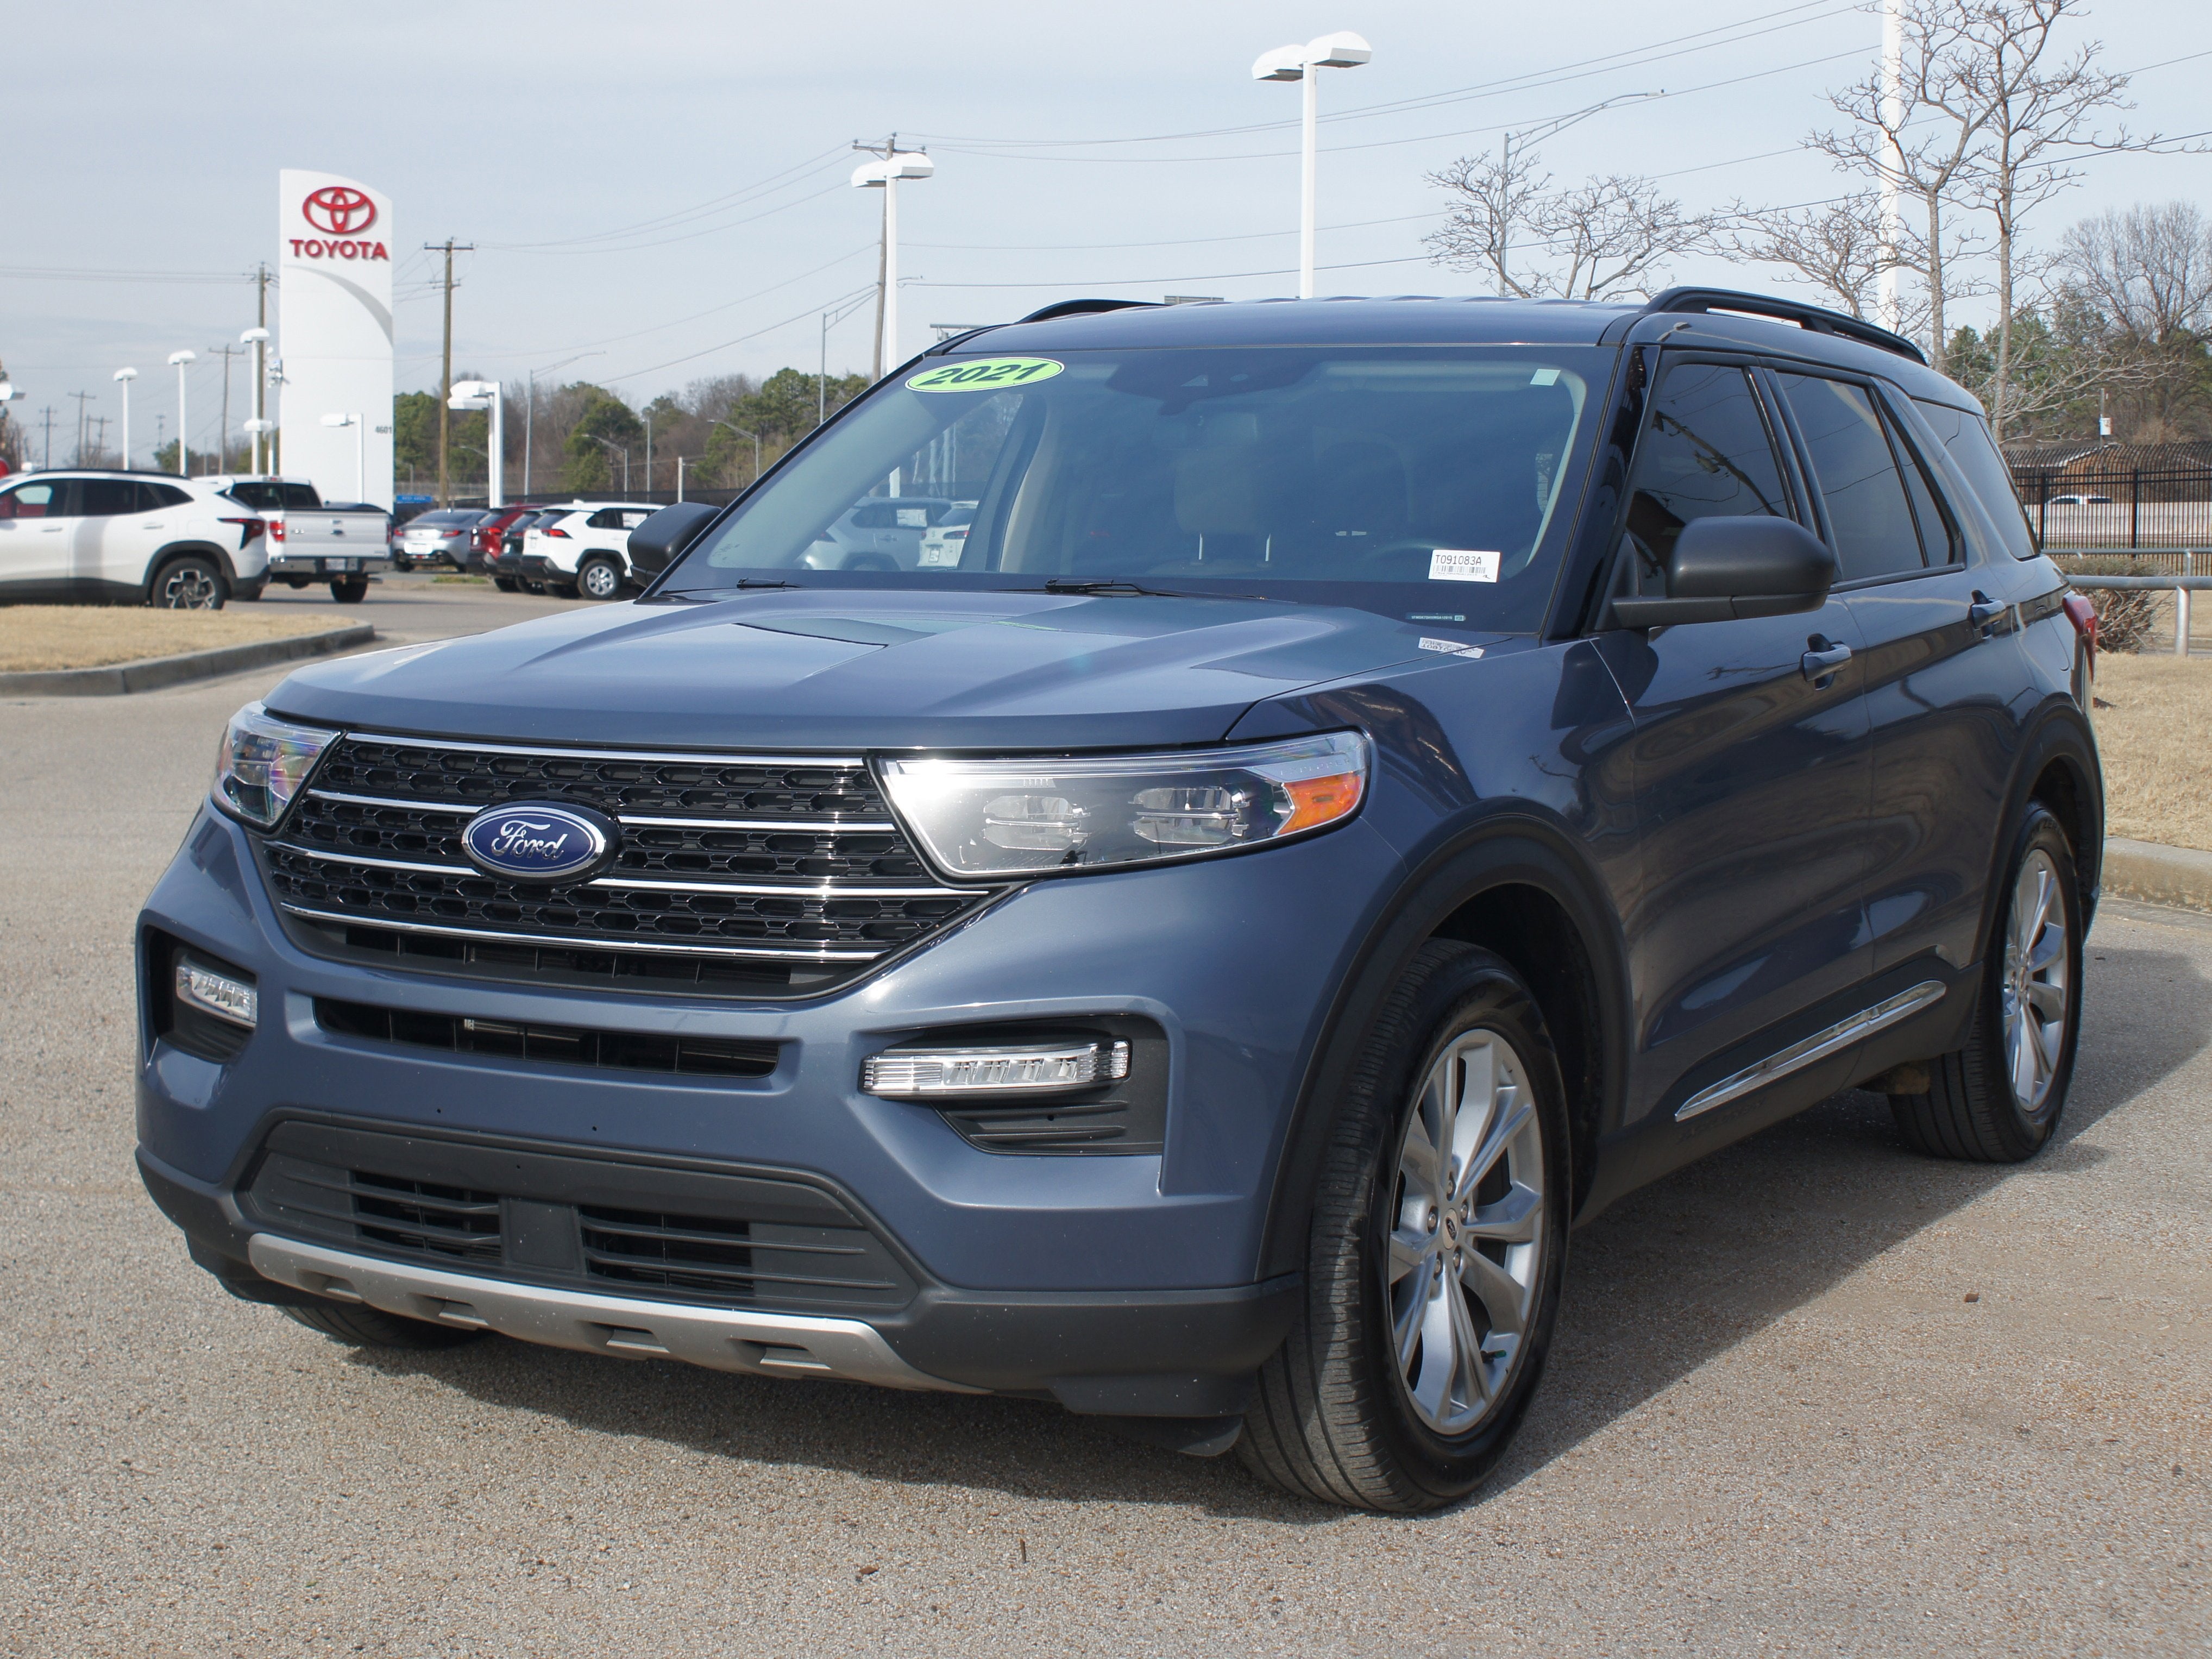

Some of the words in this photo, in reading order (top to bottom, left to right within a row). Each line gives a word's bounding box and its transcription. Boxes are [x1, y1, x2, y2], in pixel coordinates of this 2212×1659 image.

[289, 239, 389, 261] TOYOTA
[915, 363, 1050, 386] 2021
[1435, 554, 1482, 565] T091083A
[491, 820, 568, 860] Ford
